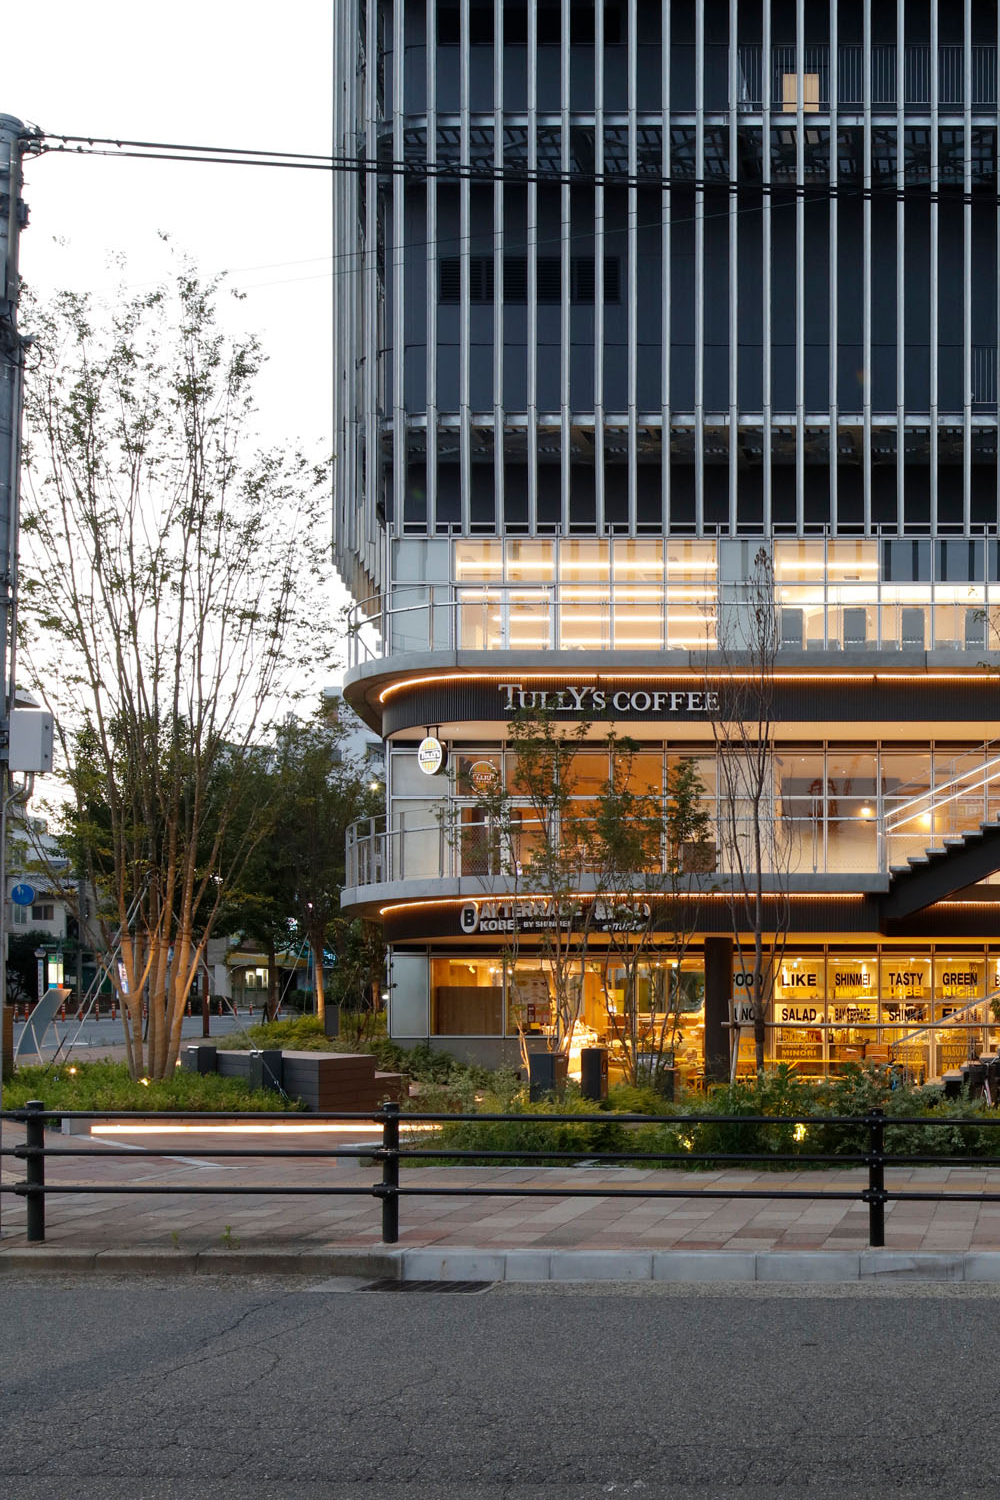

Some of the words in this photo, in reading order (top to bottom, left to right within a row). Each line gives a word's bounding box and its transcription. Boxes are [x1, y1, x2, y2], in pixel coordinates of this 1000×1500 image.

[612, 691, 720, 711] COFFEE
[781, 973, 817, 987] LIKE
[835, 972, 871, 986] SHINMEI
[888, 972, 924, 986] TASTY
[942, 972, 978, 986] GREEN
[781, 1008, 817, 1021] SALAD
[781, 1049, 817, 1058] MINORI
